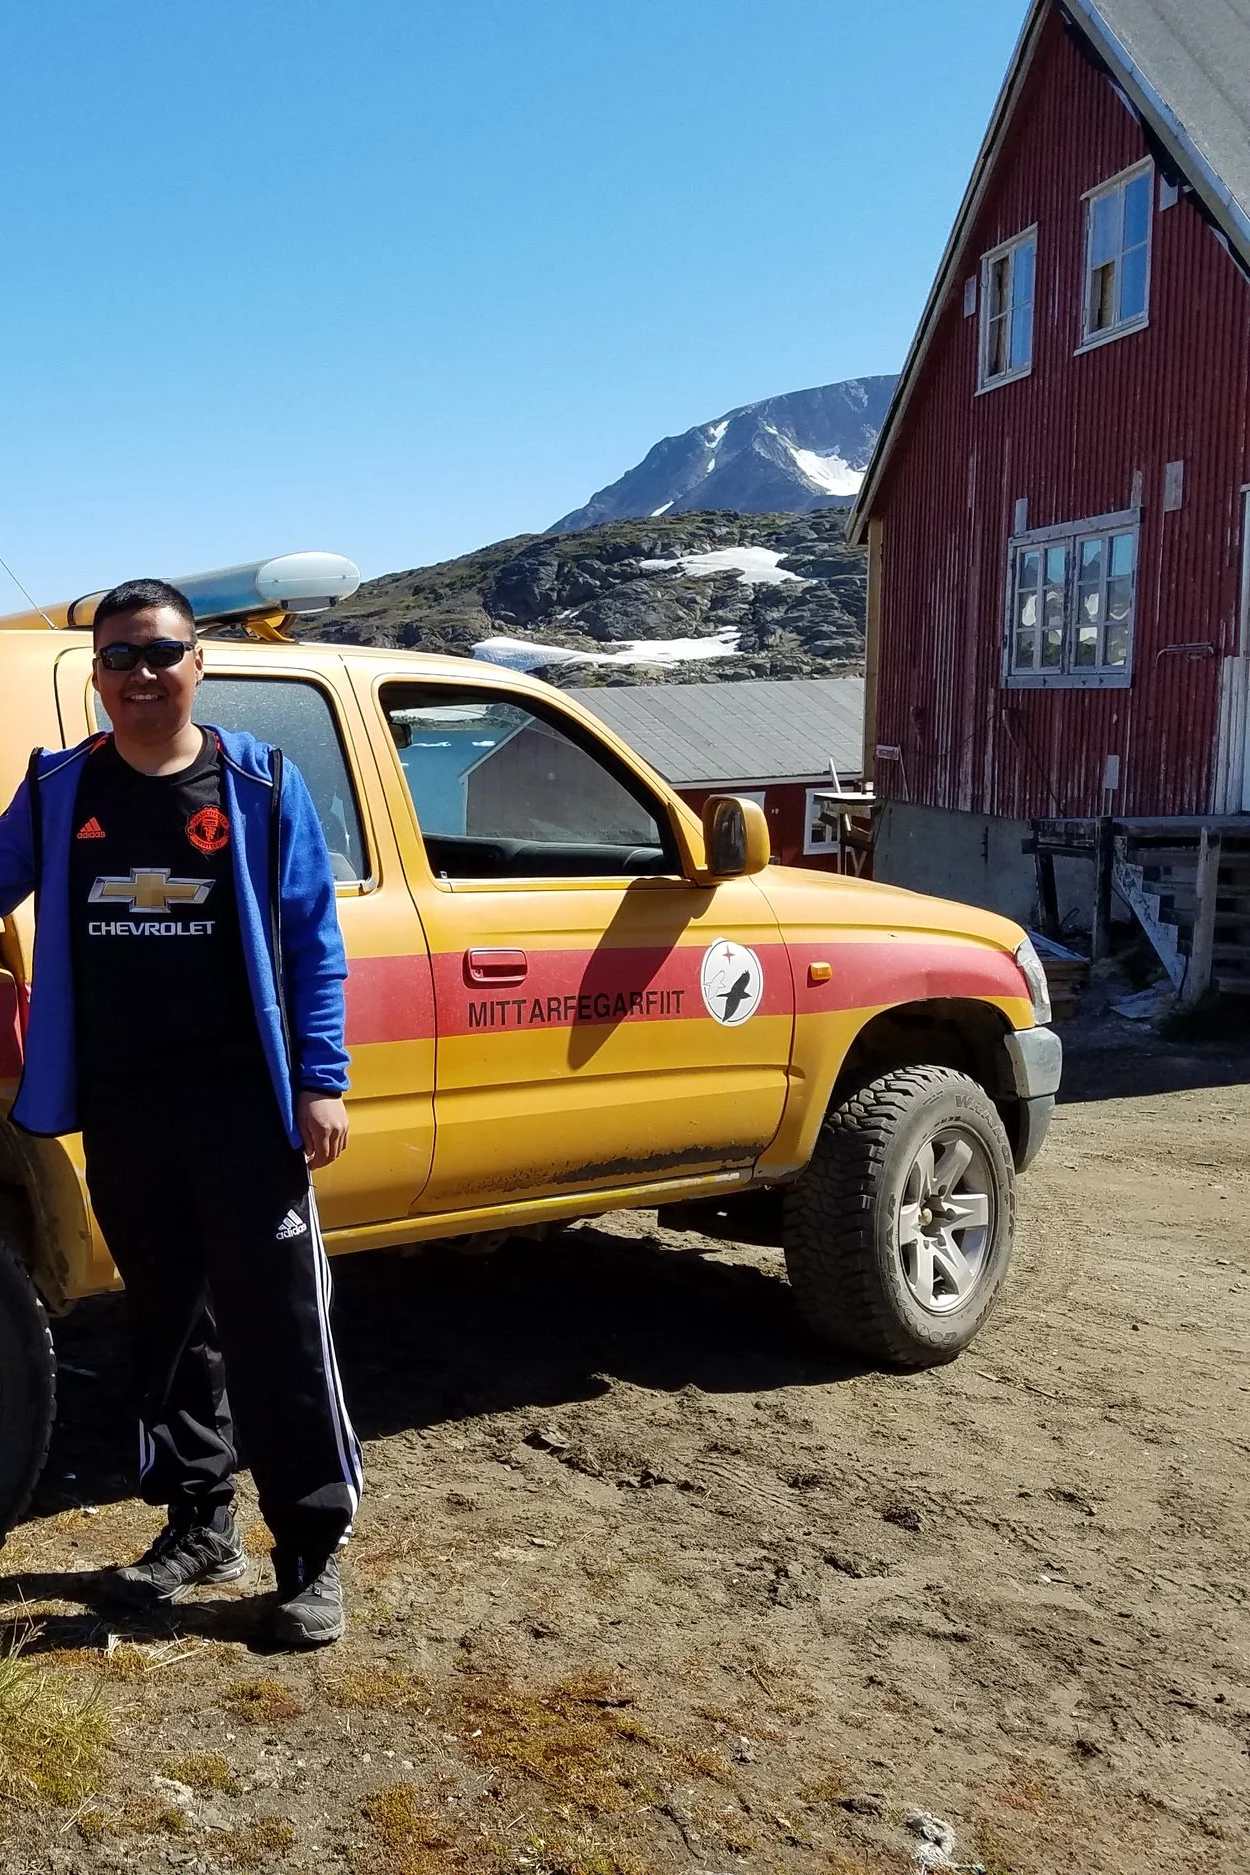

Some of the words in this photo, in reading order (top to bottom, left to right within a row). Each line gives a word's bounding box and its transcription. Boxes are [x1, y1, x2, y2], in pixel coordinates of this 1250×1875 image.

[77, 830, 106, 839] adidas
[88, 921, 216, 936] CHEVROLET
[276, 1223, 307, 1240] adidas
